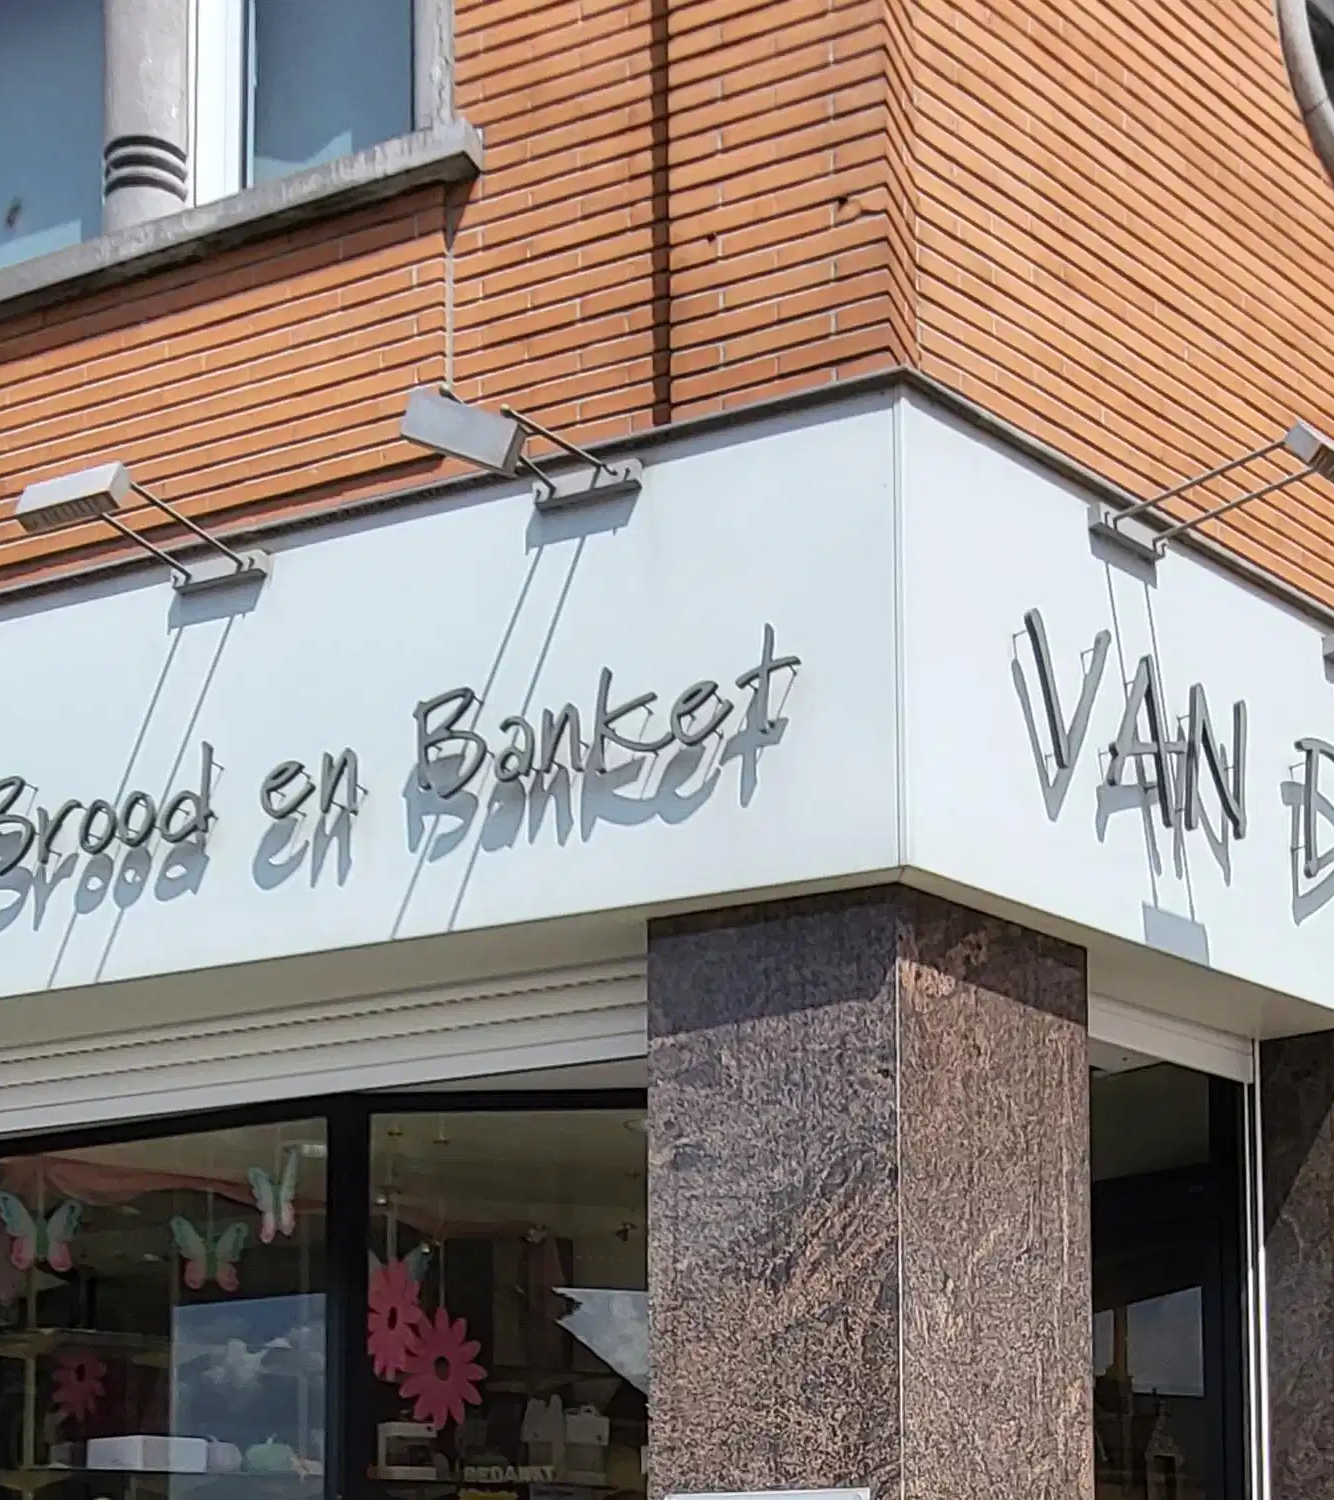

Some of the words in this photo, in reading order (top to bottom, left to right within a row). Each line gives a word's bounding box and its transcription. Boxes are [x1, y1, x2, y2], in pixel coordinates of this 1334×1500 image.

[261, 744, 362, 820] en
[413, 622, 802, 798] Banket
[1024, 608, 1247, 839] VAN
